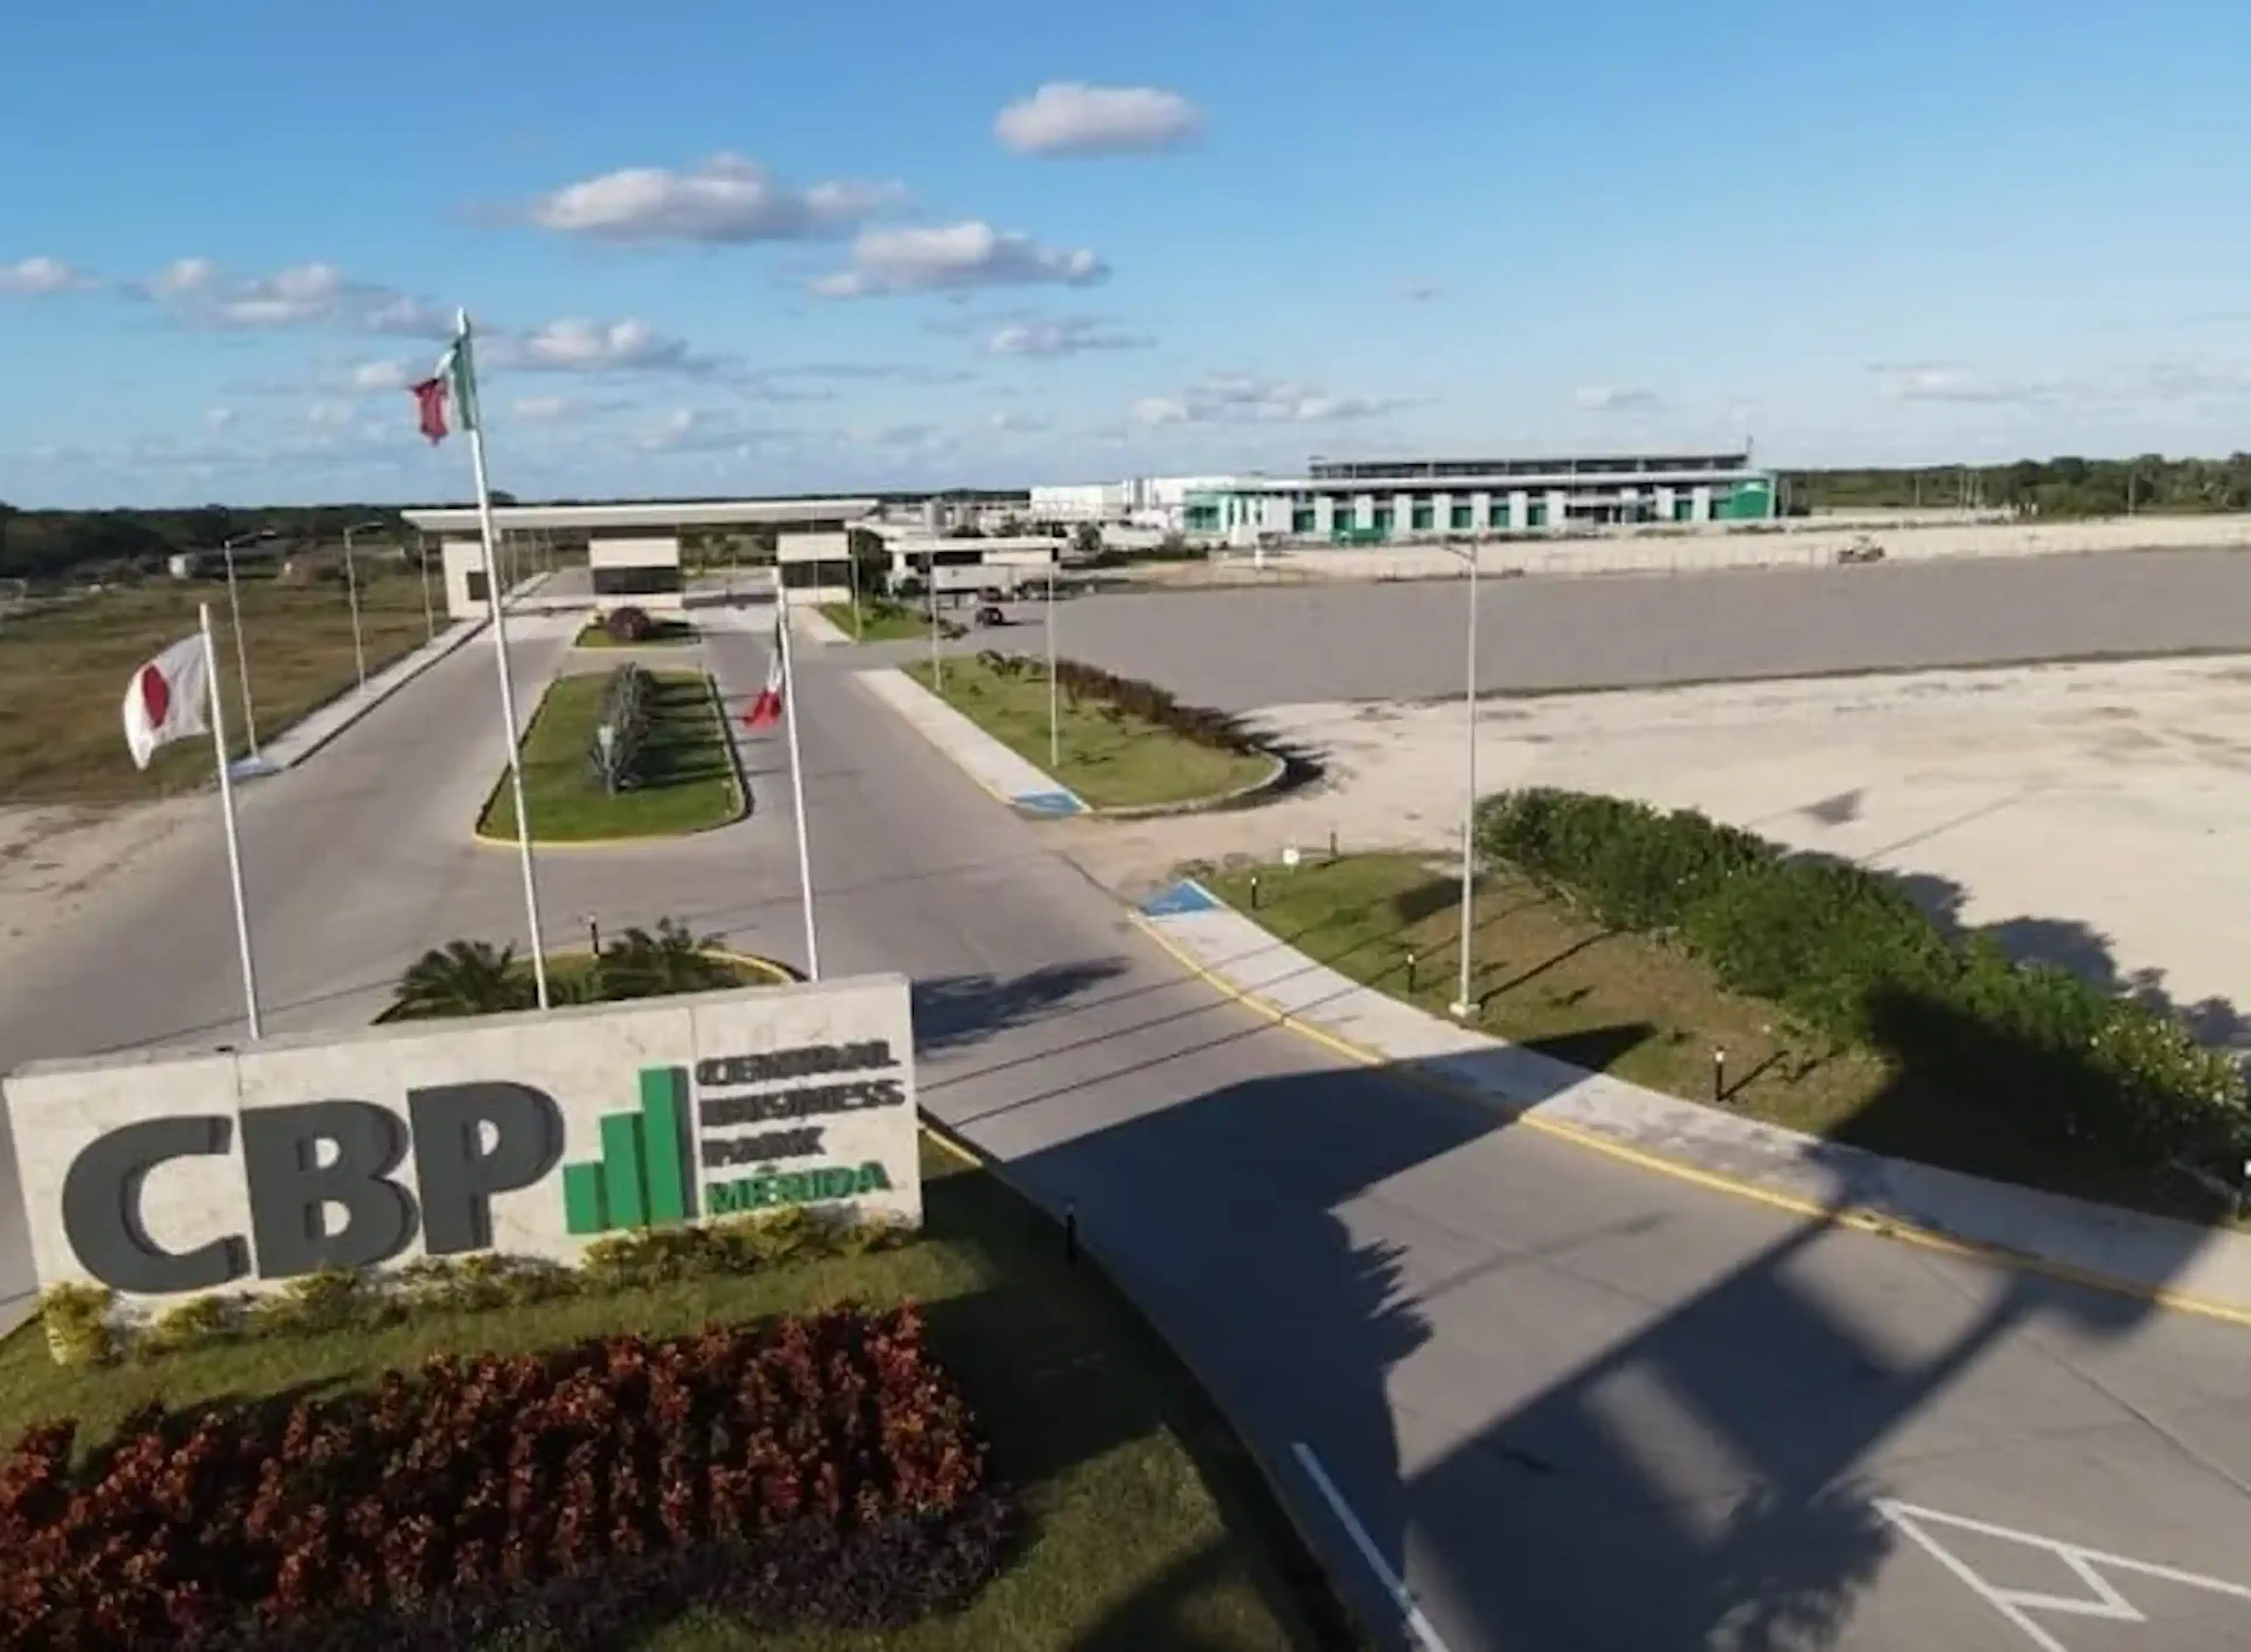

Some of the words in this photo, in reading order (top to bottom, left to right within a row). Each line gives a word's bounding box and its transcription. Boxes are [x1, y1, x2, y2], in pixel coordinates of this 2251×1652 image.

[696, 1039, 902, 1086] CENTRAL
[699, 1079, 906, 1126] BUSINESS
[701, 1126, 827, 1168] PARK
[62, 1081, 564, 1293] CBP
[705, 1160, 893, 1214] MÉRIDA
